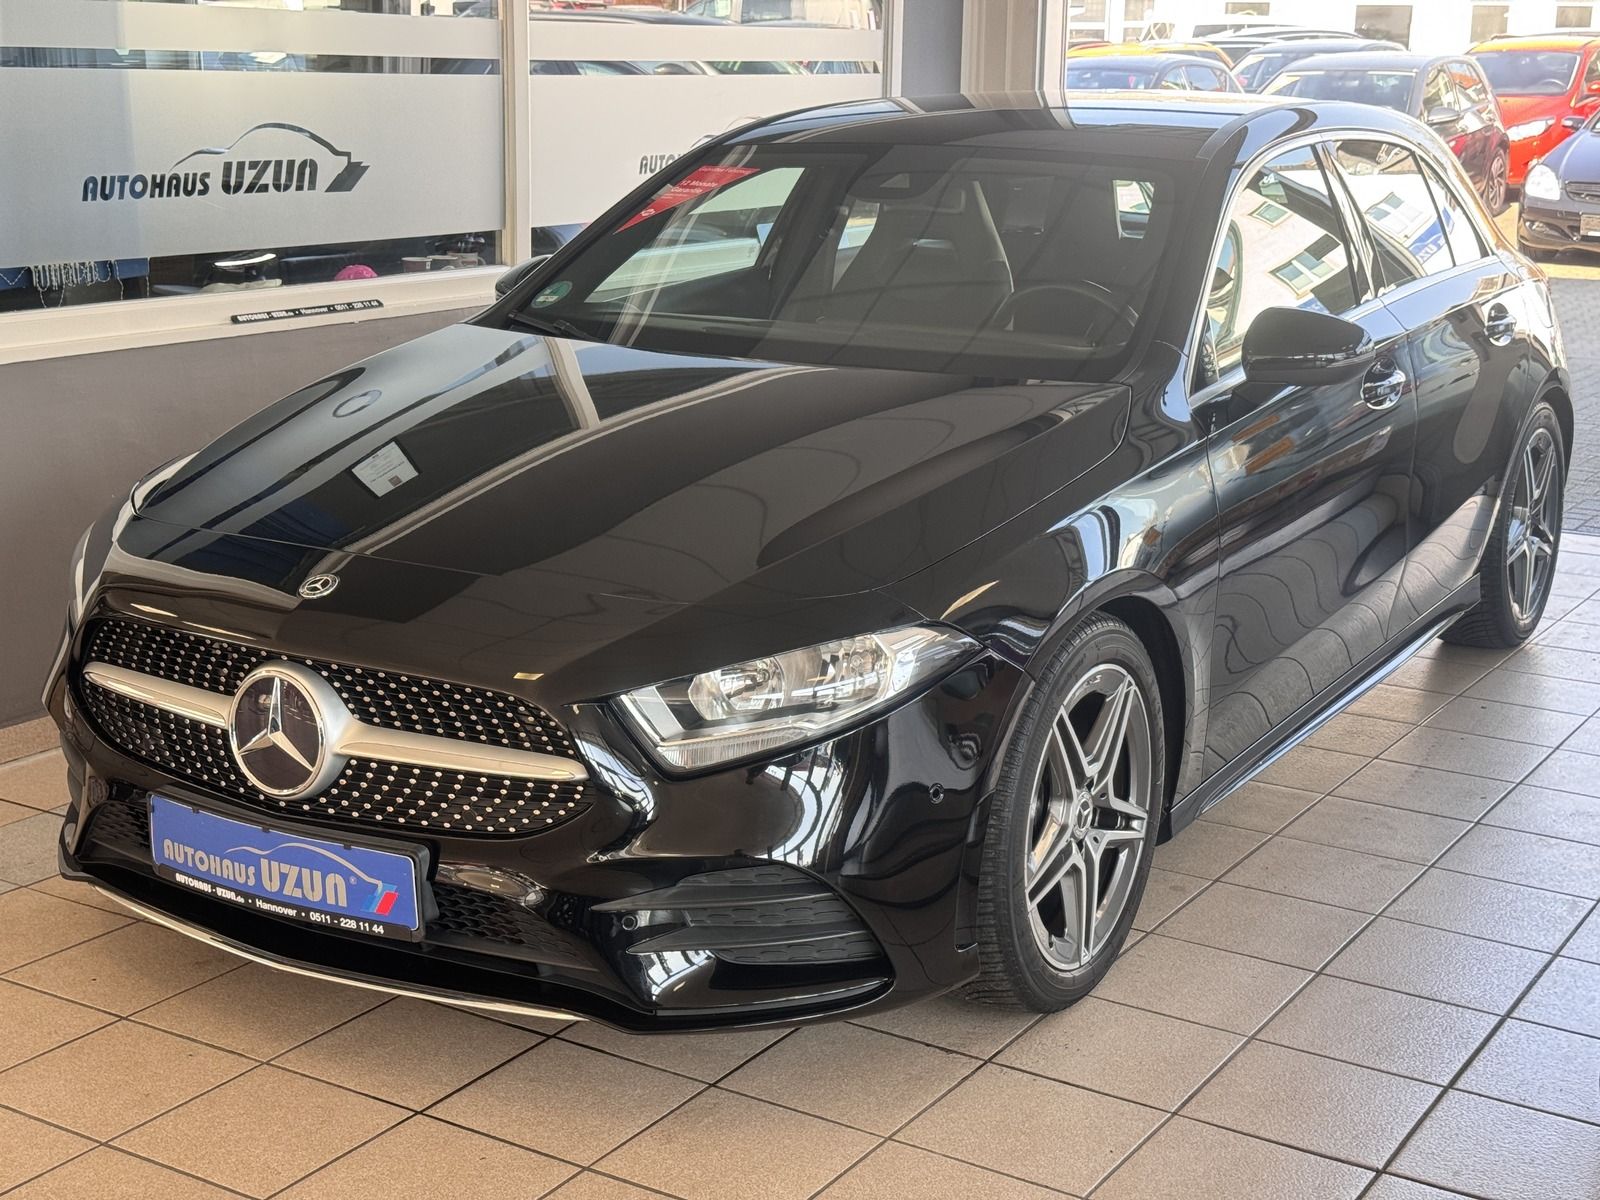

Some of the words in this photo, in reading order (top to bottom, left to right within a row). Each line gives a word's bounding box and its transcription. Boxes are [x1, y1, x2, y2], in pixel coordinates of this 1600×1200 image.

[82, 172, 210, 201] AUTOHAUS
[221, 159, 318, 195] UZUN
[163, 838, 256, 886] AUTOHAUS
[260, 858, 347, 907] UZUN
[255, 898, 298, 917] Hannover
[310, 911, 331, 924] 0511
[340, 917, 357, 929] 228
[359, 921, 370, 931] 11
[372, 924, 385, 935] 44
